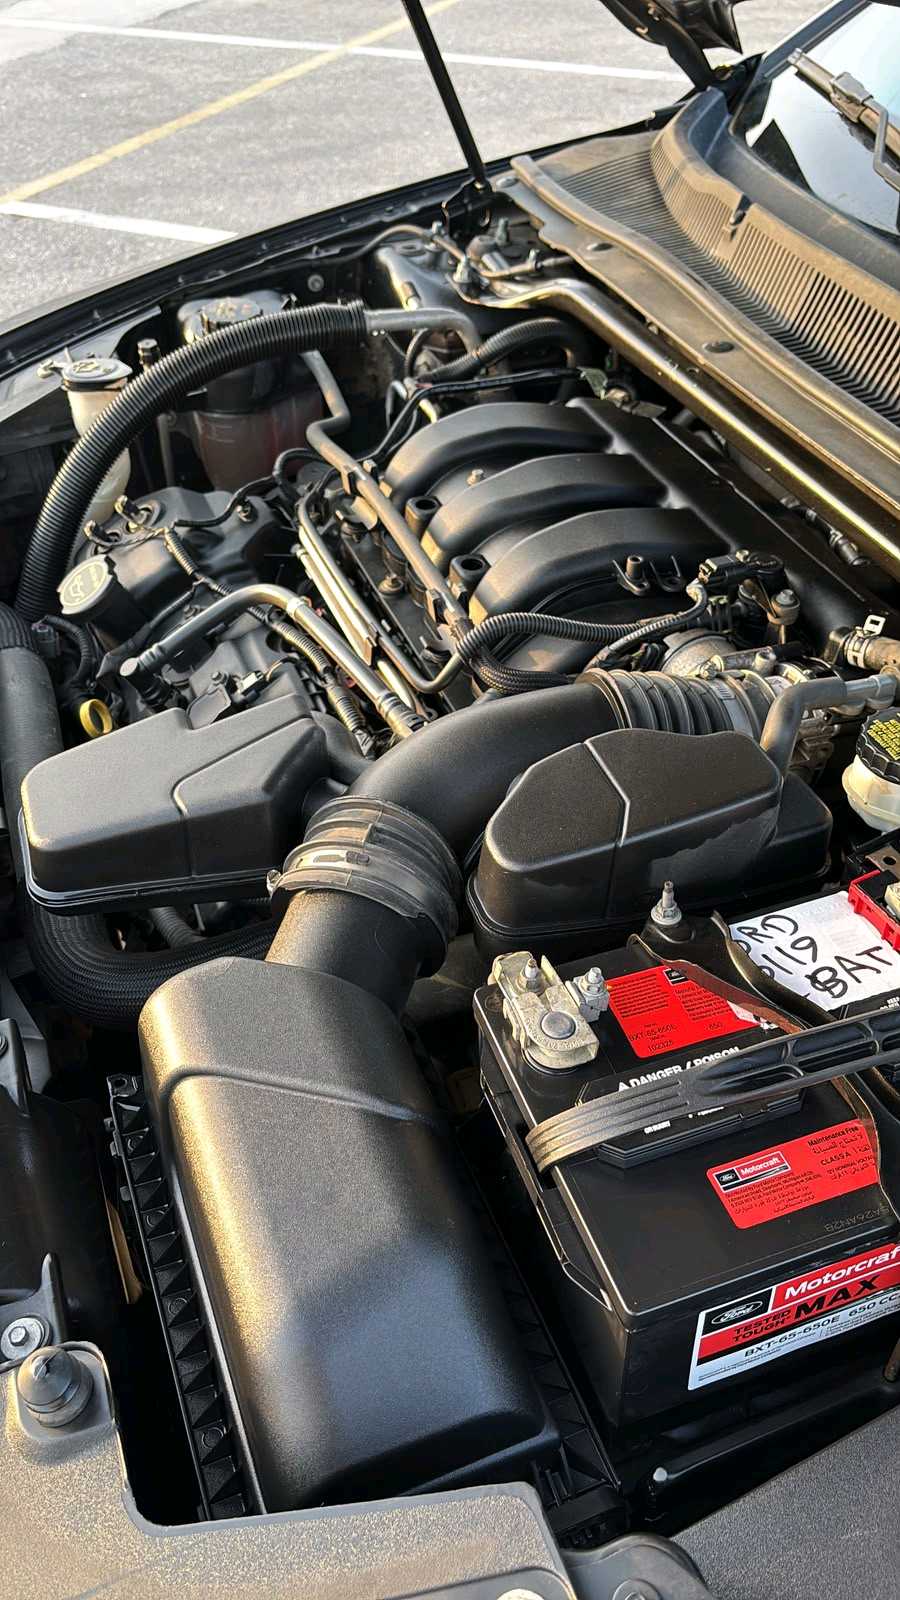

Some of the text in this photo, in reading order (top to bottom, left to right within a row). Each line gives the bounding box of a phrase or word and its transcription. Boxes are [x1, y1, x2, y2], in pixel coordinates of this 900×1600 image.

[807, 1126, 860, 1147] Maintenance Free
[740, 1157, 781, 1177] Motorcraft
[784, 1244, 900, 1301] Motorcraf
[794, 1275, 881, 1319] MAX
[732, 1320, 785, 1343] TOUGH
[733, 1310, 791, 1335] TESTED
[744, 1315, 841, 1358] BXT-65-650E
[848, 1301, 877, 1318] 650
[879, 1292, 900, 1308] CC
